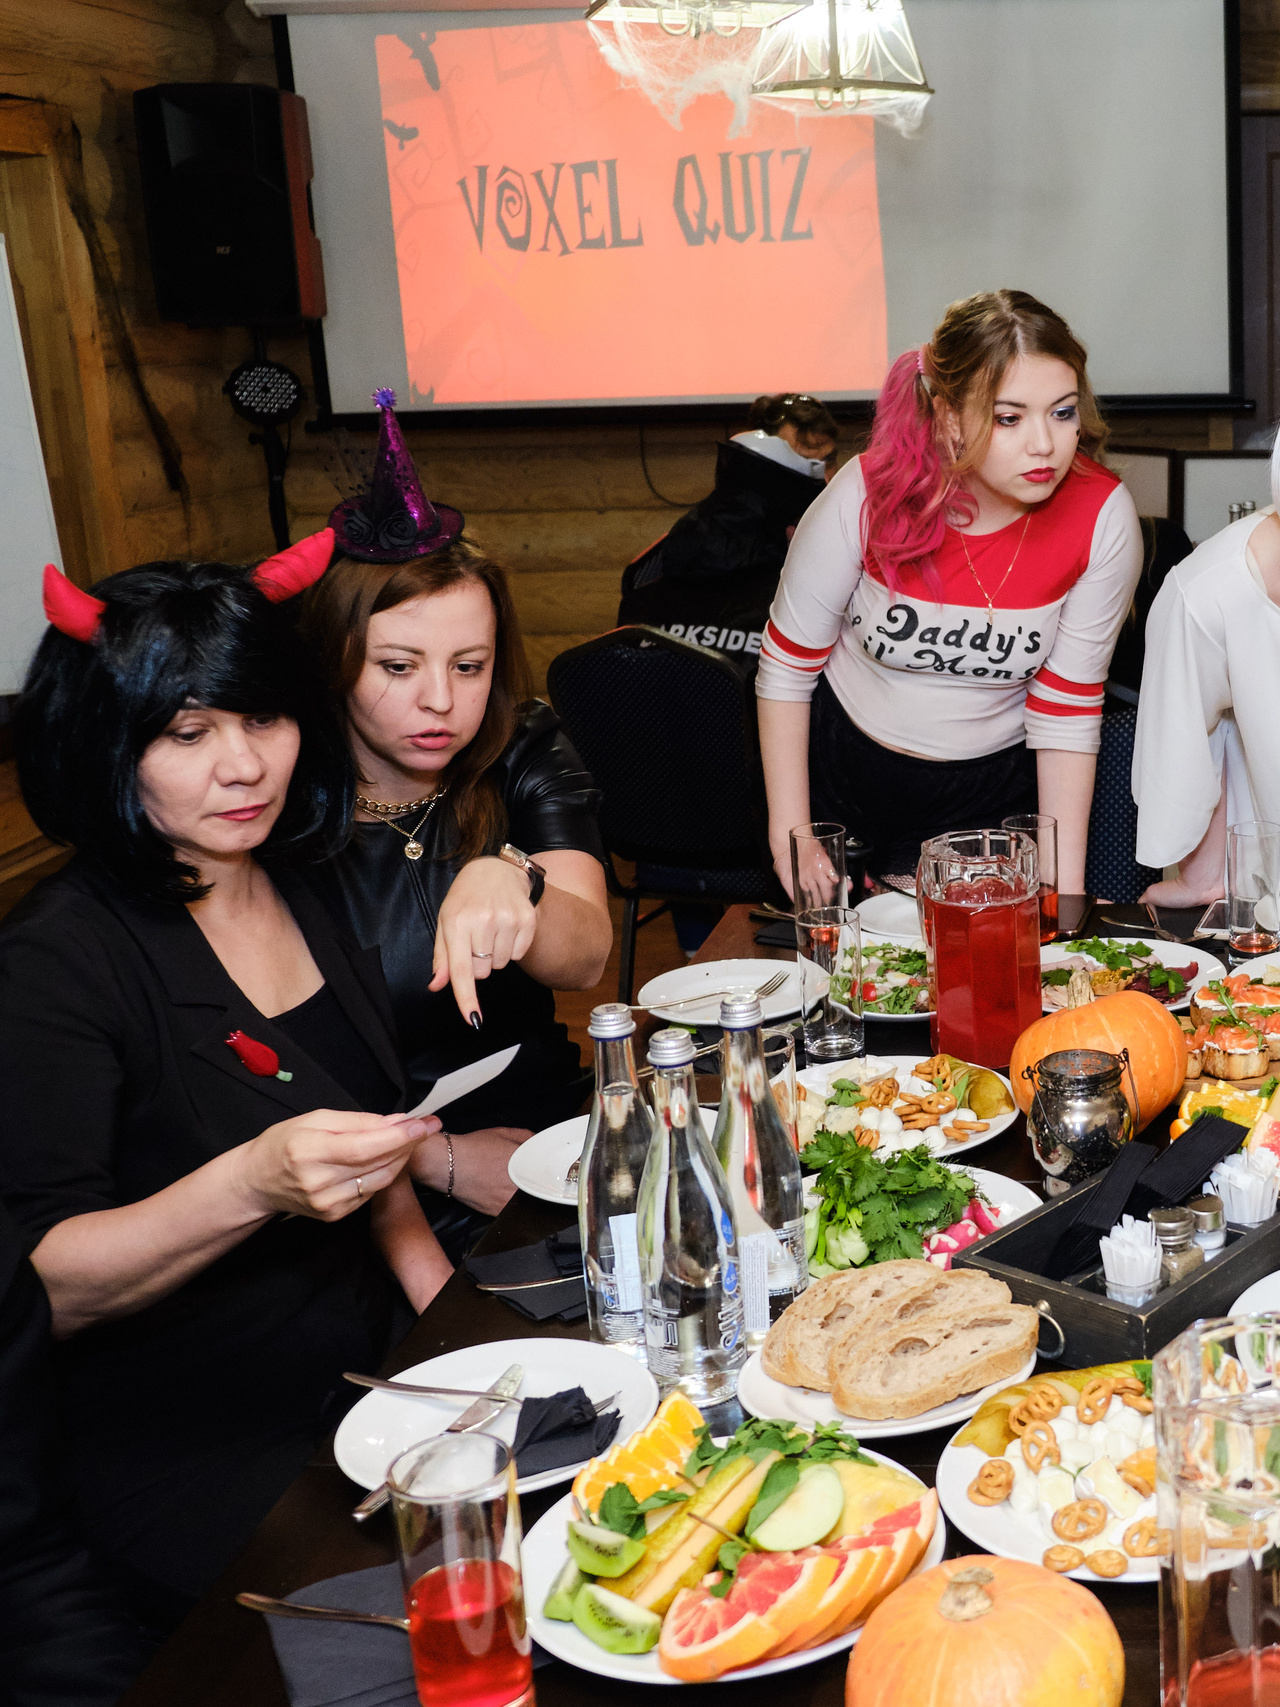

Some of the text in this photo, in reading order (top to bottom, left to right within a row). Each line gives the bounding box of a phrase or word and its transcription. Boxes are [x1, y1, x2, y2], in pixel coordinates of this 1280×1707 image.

[456, 147, 814, 257] VOXEL QUIZ
[660, 624, 763, 655] RKSIDE
[876, 604, 1042, 664] Daddy's
